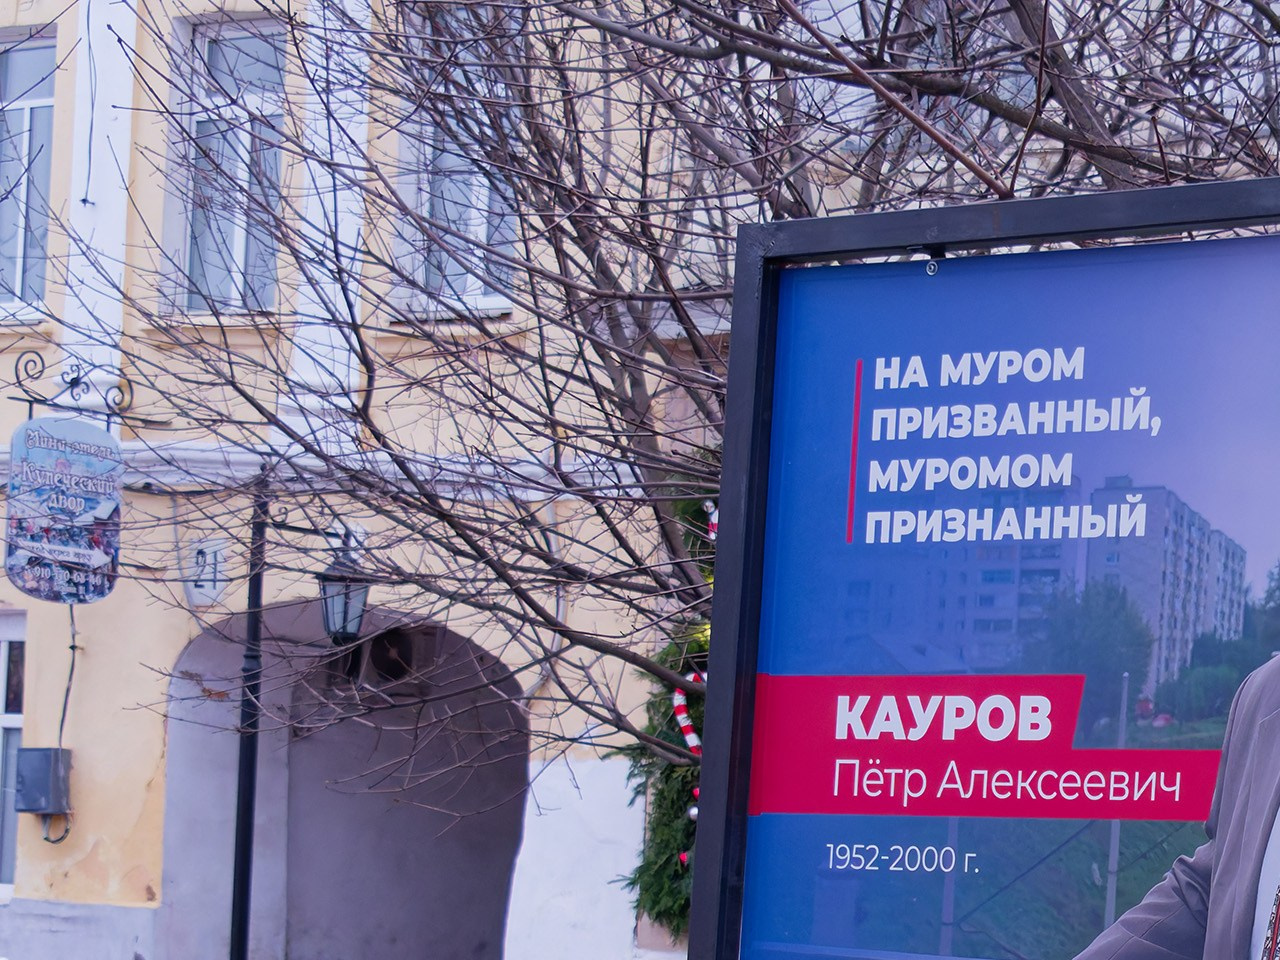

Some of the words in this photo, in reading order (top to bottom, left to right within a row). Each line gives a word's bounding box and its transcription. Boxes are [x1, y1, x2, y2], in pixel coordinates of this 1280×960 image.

[874, 356, 929, 390] НА
[940, 346, 1085, 386] МУРОМ
[871, 386, 1162, 441] ПРИЗВАННЫЙ,
[22, 457, 115, 495] Купеческий
[868, 452, 1073, 493] МУРОМОМ
[865, 493, 1147, 544] ПРИЗНАННЫЙ
[194, 549, 218, 590] 21
[834, 694, 1053, 742] КАУРОВ
[832, 758, 927, 807] Пётр
[936, 760, 1182, 802] Алексеевич
[826, 844, 956, 873] 1952-2000
[964, 850, 980, 874] г.
